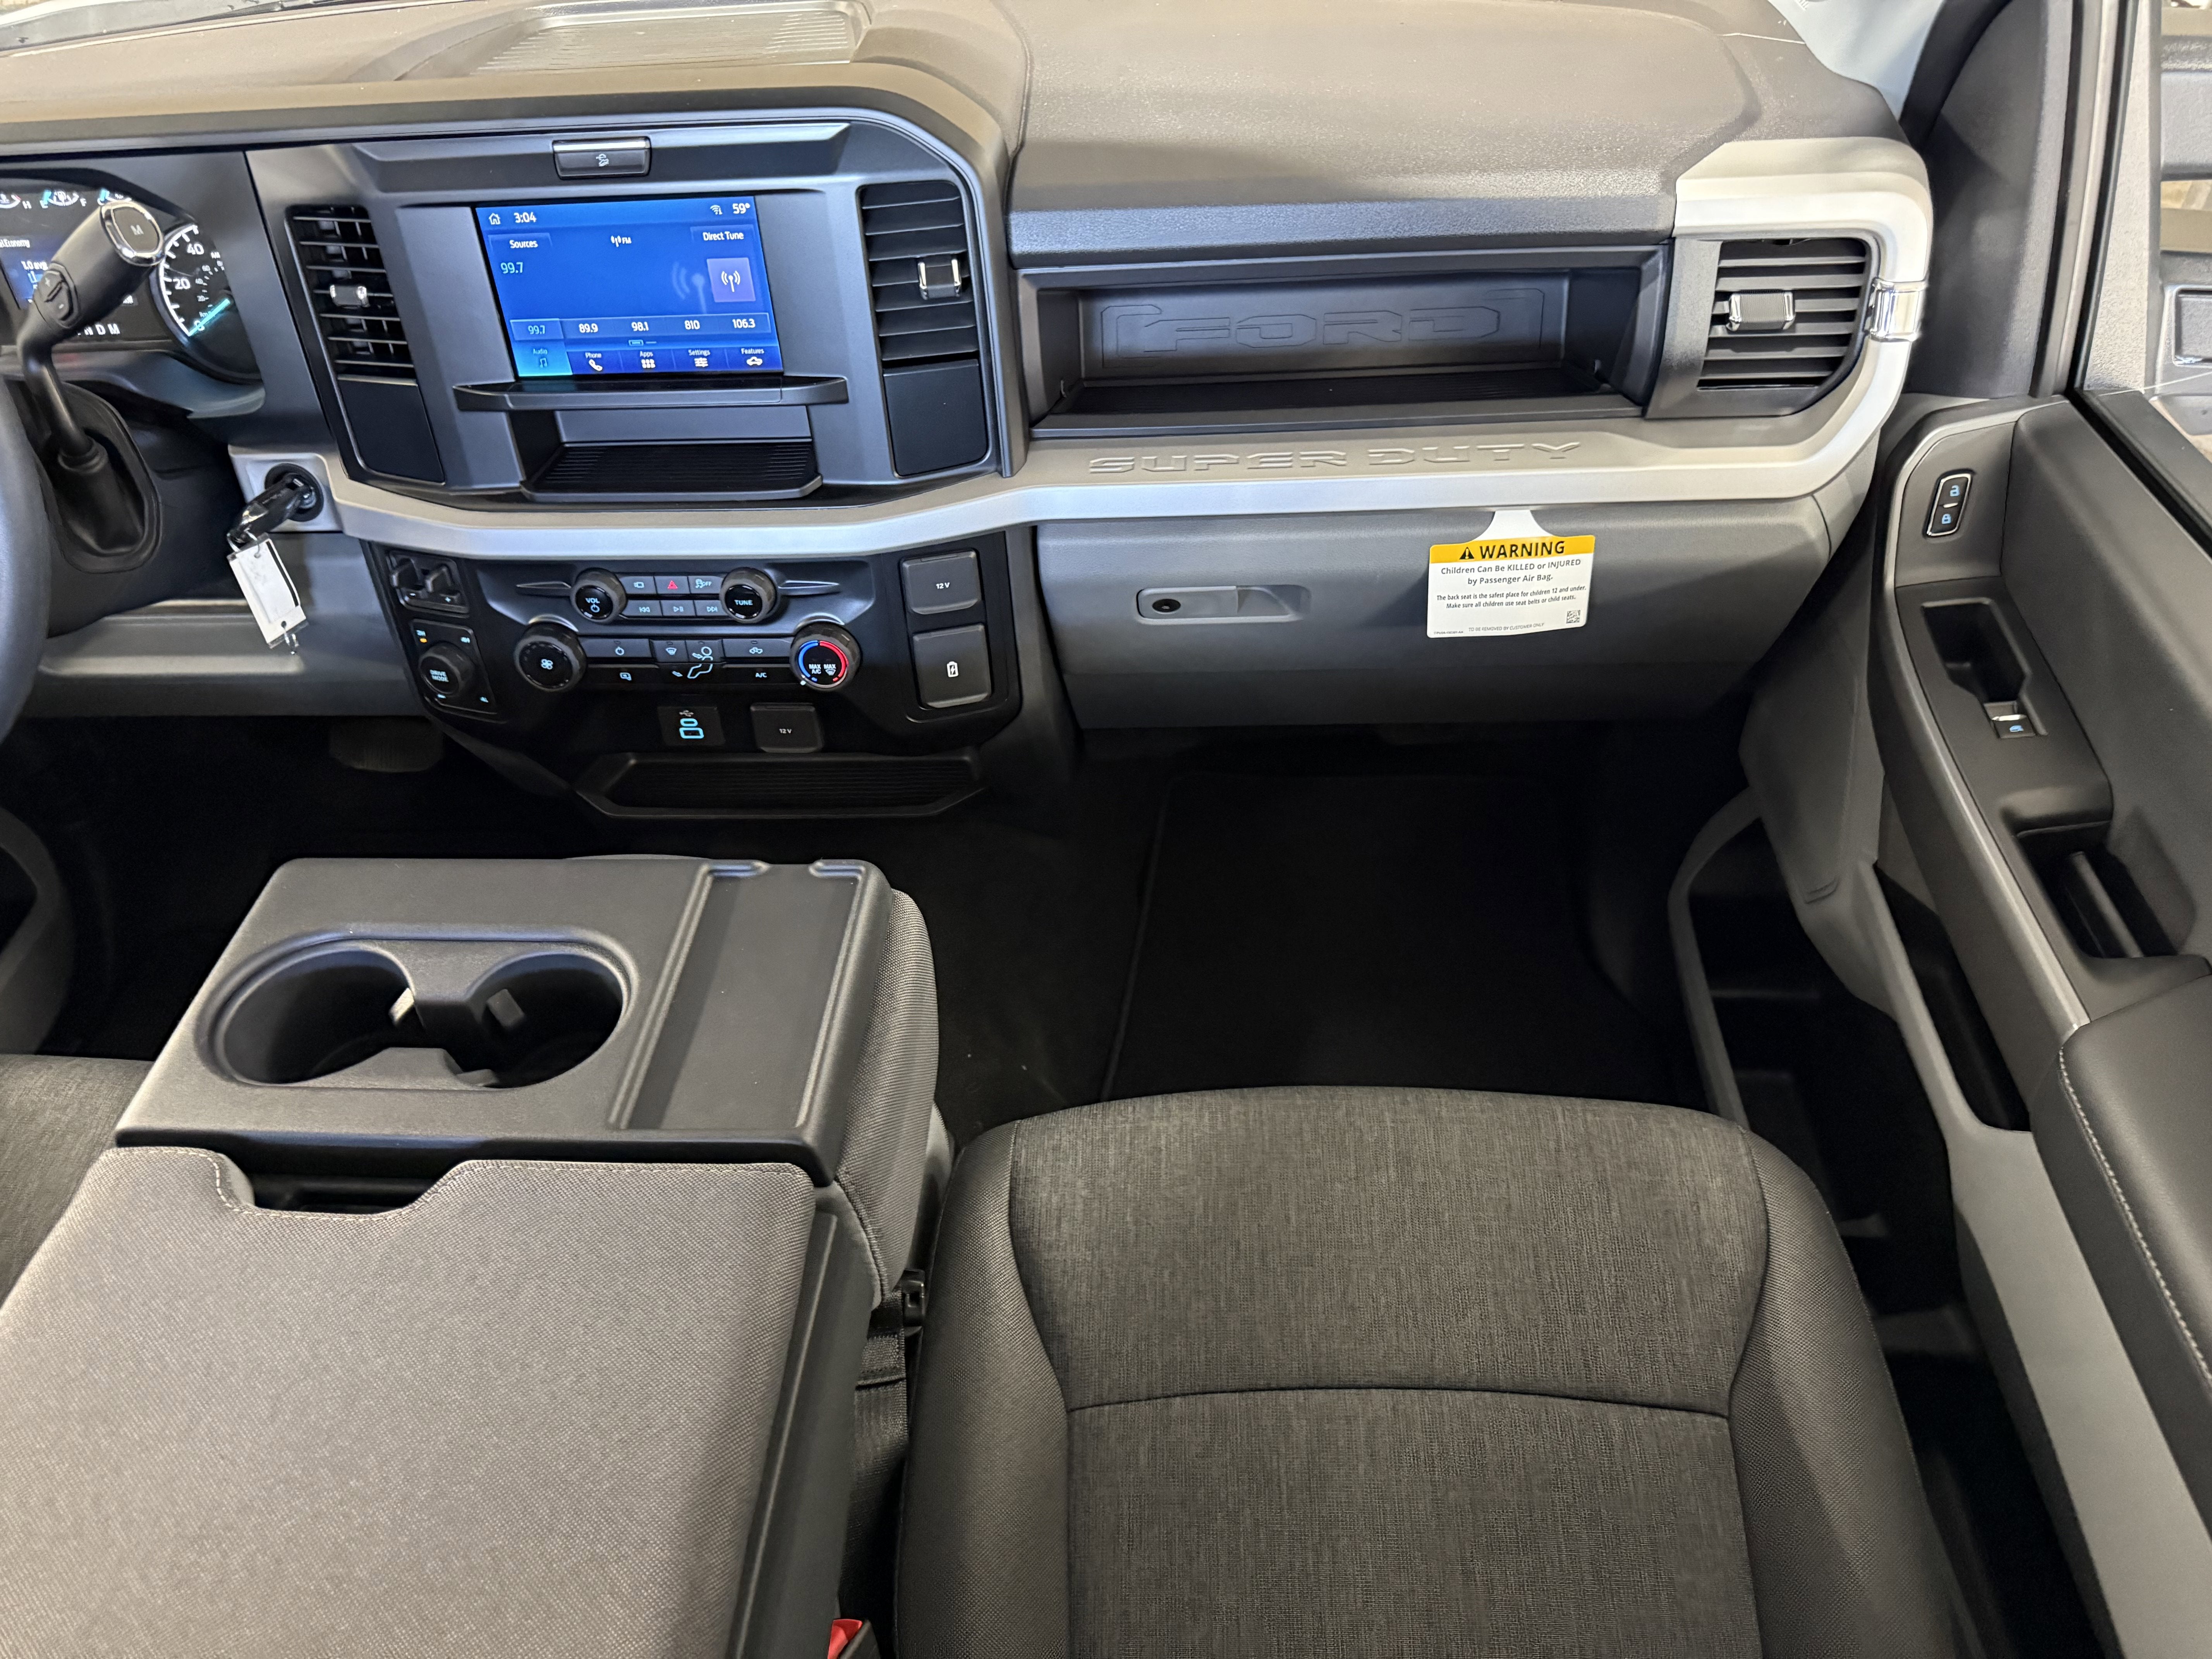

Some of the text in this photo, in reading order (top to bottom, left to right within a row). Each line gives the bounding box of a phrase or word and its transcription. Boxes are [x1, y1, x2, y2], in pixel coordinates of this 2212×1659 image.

[80, 198, 87, 206] F
[515, 212, 536, 223] 3:04
[131, 225, 144, 235] M
[703, 231, 744, 240] Direct Tune
[187, 243, 204, 254] 40
[510, 239, 538, 248] Sources
[501, 262, 524, 274] 99.7
[173, 278, 191, 290] 20
[579, 324, 598, 333] 89.9
[632, 322, 649, 331] 98.1
[685, 320, 700, 330] 810
[732, 319, 756, 328] 106.3
[95, 324, 105, 335] D
[107, 324, 120, 335] M
[528, 325, 545, 335] 99.7
[1142, 306, 1500, 353] FORD
[1089, 441, 1581, 473] SUPER DUTY
[1480, 541, 1565, 559] WARNING
[1548, 559, 1581, 568] INJURED
[1468, 577, 1477, 586] by
[1480, 575, 1521, 584] Passenger
[1537, 574, 1553, 582] Bag.
